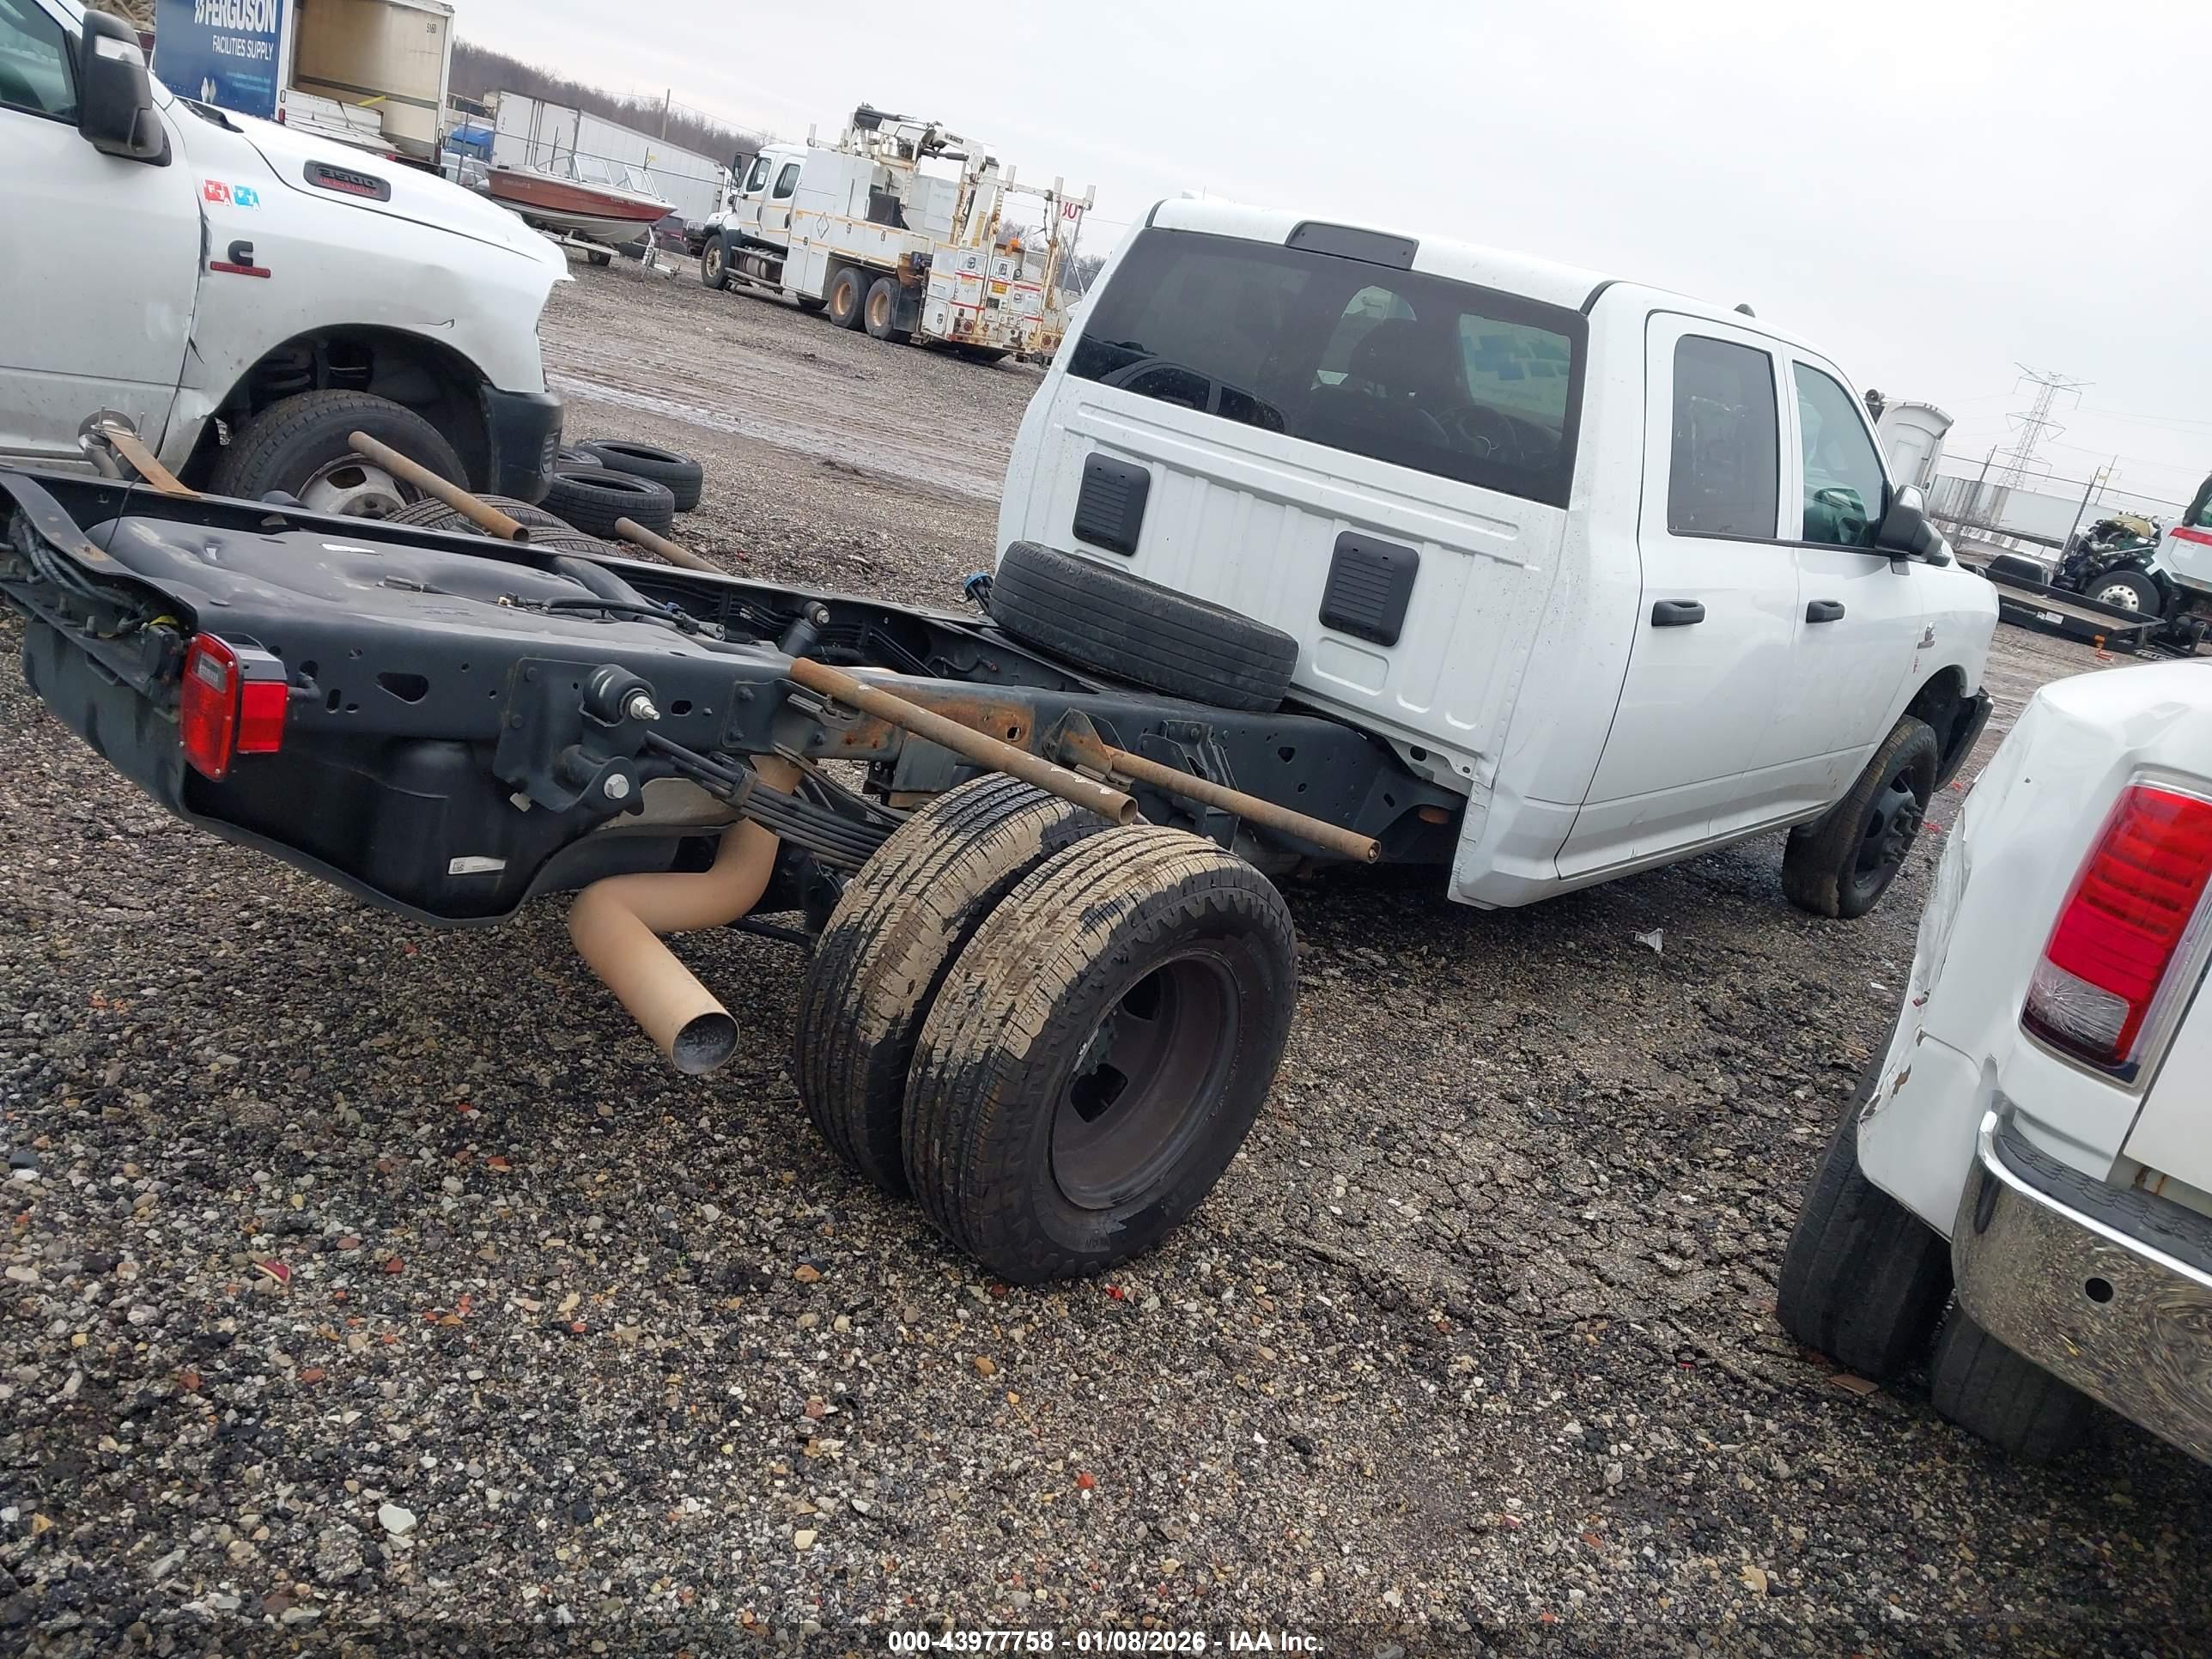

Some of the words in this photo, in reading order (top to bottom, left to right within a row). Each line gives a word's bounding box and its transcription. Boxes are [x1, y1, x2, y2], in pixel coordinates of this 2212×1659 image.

[204, 0, 276, 33] FERGUSON
[212, 34, 246, 58] FACILITIES
[246, 40, 274, 61] SUPPLY
[317, 167, 378, 190] 3500
